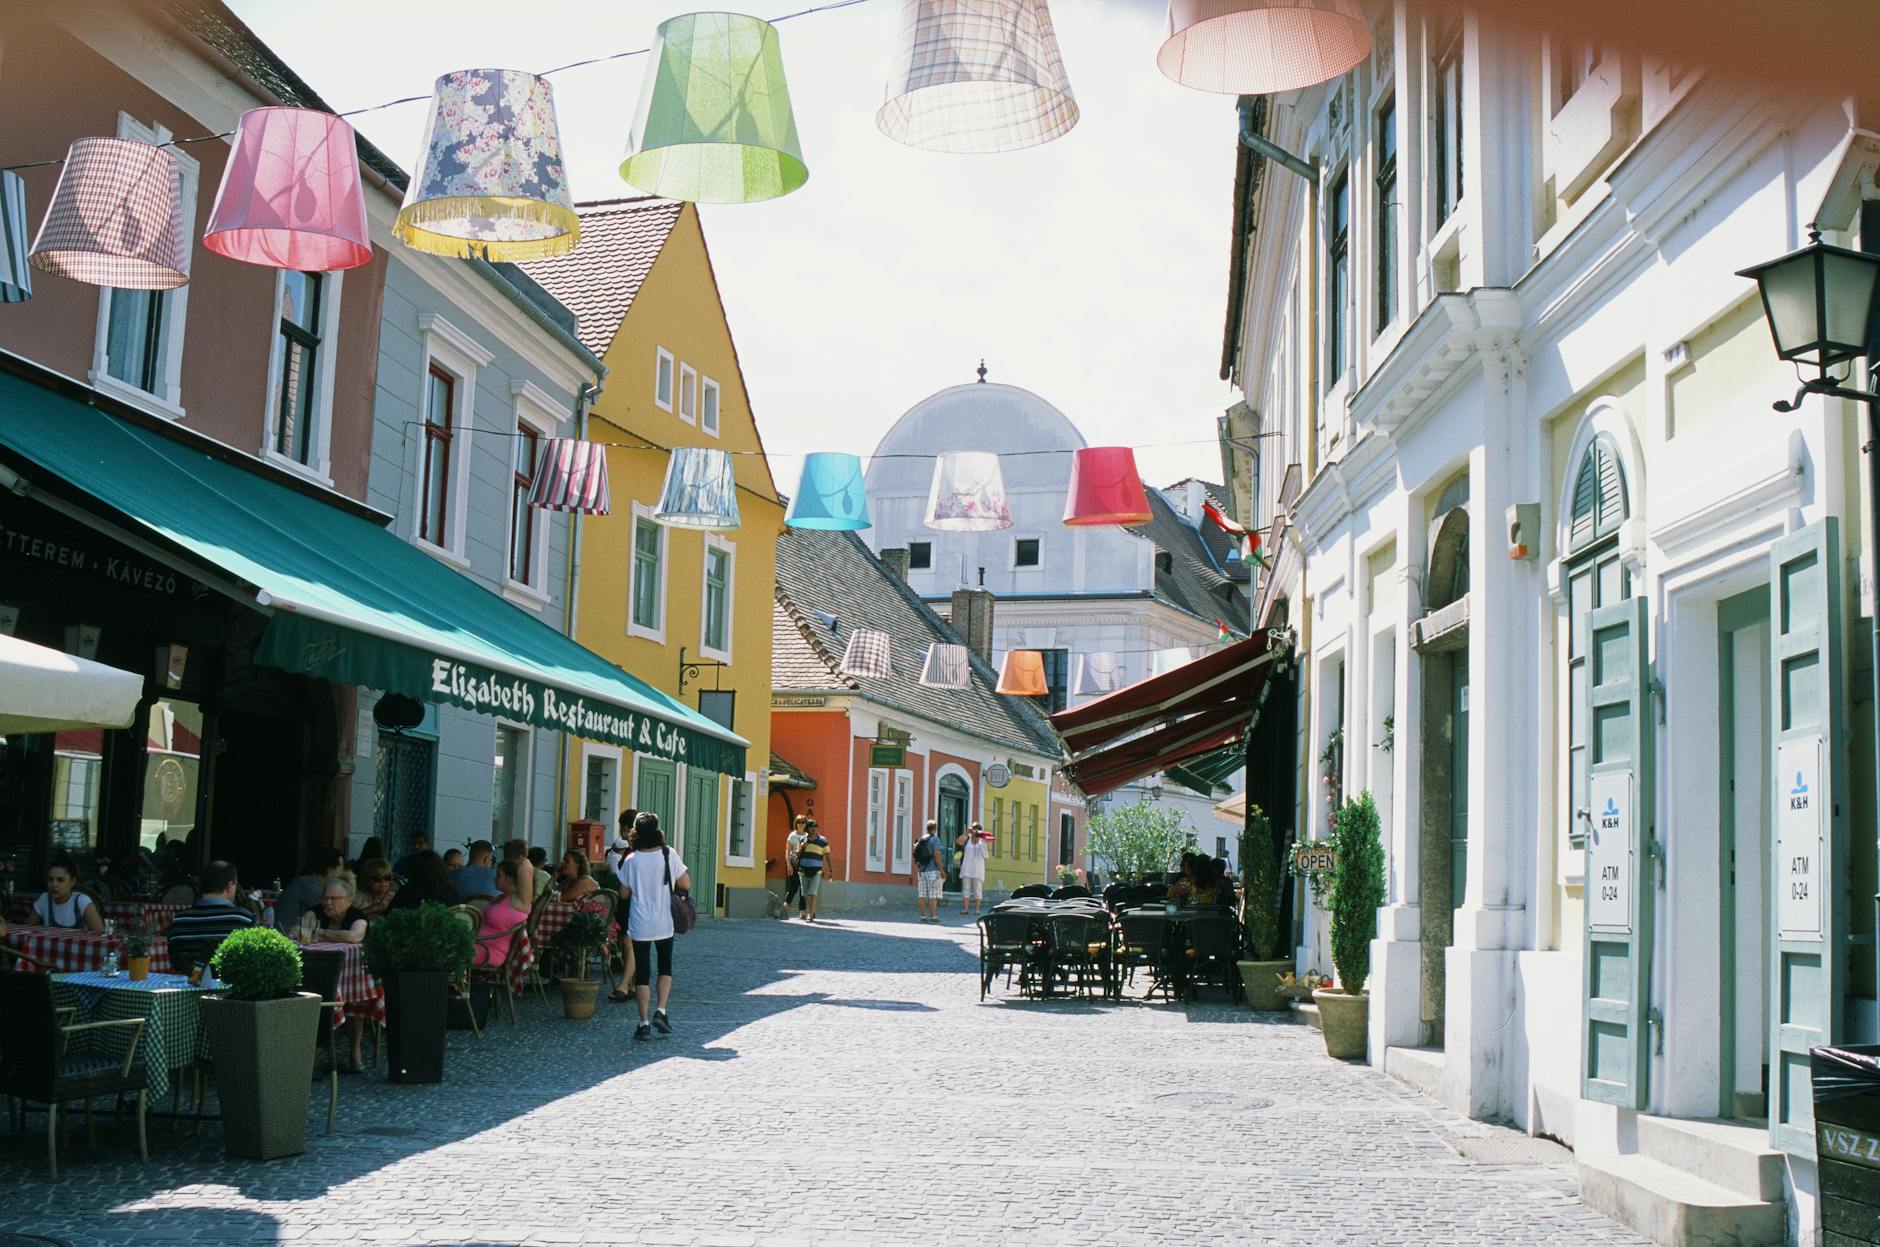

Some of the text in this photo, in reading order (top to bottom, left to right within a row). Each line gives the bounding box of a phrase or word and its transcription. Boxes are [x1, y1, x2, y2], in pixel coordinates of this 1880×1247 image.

[107, 557, 177, 594] KÁVÉZÓ
[431, 658, 687, 757] Elisabeth Restaurant & Cafe
[1790, 796, 1809, 810] K&H
[1602, 818, 1620, 829] K&H
[1301, 855, 1335, 869] OPEN
[1791, 857, 1809, 875] ATM
[1602, 866, 1619, 880] ATM
[1602, 886, 1618, 900] 0-24
[1791, 881, 1809, 900] 0-24
[1823, 1129, 1861, 1157] VSZ
